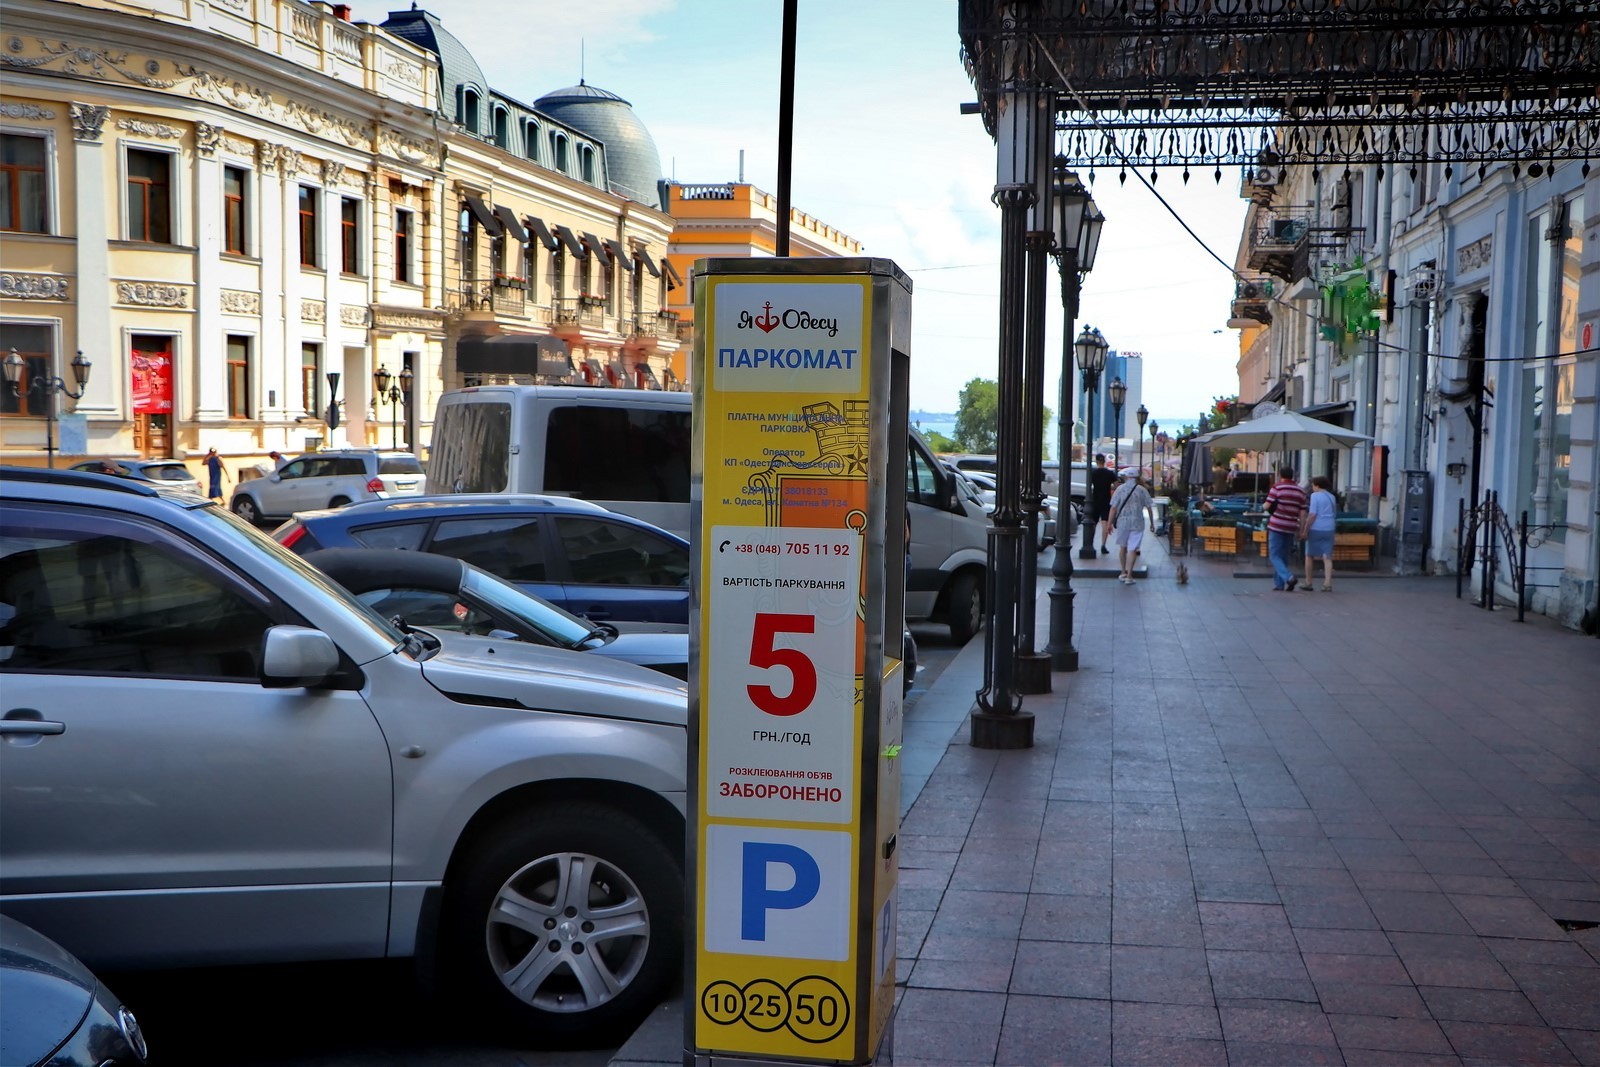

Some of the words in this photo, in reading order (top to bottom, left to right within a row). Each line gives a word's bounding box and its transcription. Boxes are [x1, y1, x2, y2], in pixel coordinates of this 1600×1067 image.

[737, 310, 753, 329] Я
[782, 309, 838, 338] Одесу
[719, 348, 857, 369] ПАРКОМАТ
[728, 412, 766, 422] ПЛАТНА
[760, 425, 810, 433] ПАРКОВКА
[762, 448, 805, 457] Оператор
[724, 458, 737, 466] КП
[734, 498, 764, 508] Одеса,
[735, 544, 753, 553] +38
[756, 544, 781, 555] (048)
[786, 543, 810, 555] 705
[814, 544, 829, 556] 11
[834, 544, 850, 556] 92
[722, 578, 772, 588] ВАРТІСТЬ
[774, 578, 845, 590] ПАРКУВАННЯ
[746, 613, 818, 717] 5
[753, 731, 811, 746] ГРН./ГОД
[729, 767, 804, 779] РОЗКЛЕЮВАННЯ
[720, 782, 842, 802] ЗАБОРОНЕНО
[741, 841, 821, 942] P
[710, 994, 737, 1014] 10
[748, 994, 781, 1018] 25
[795, 994, 838, 1026] 50
